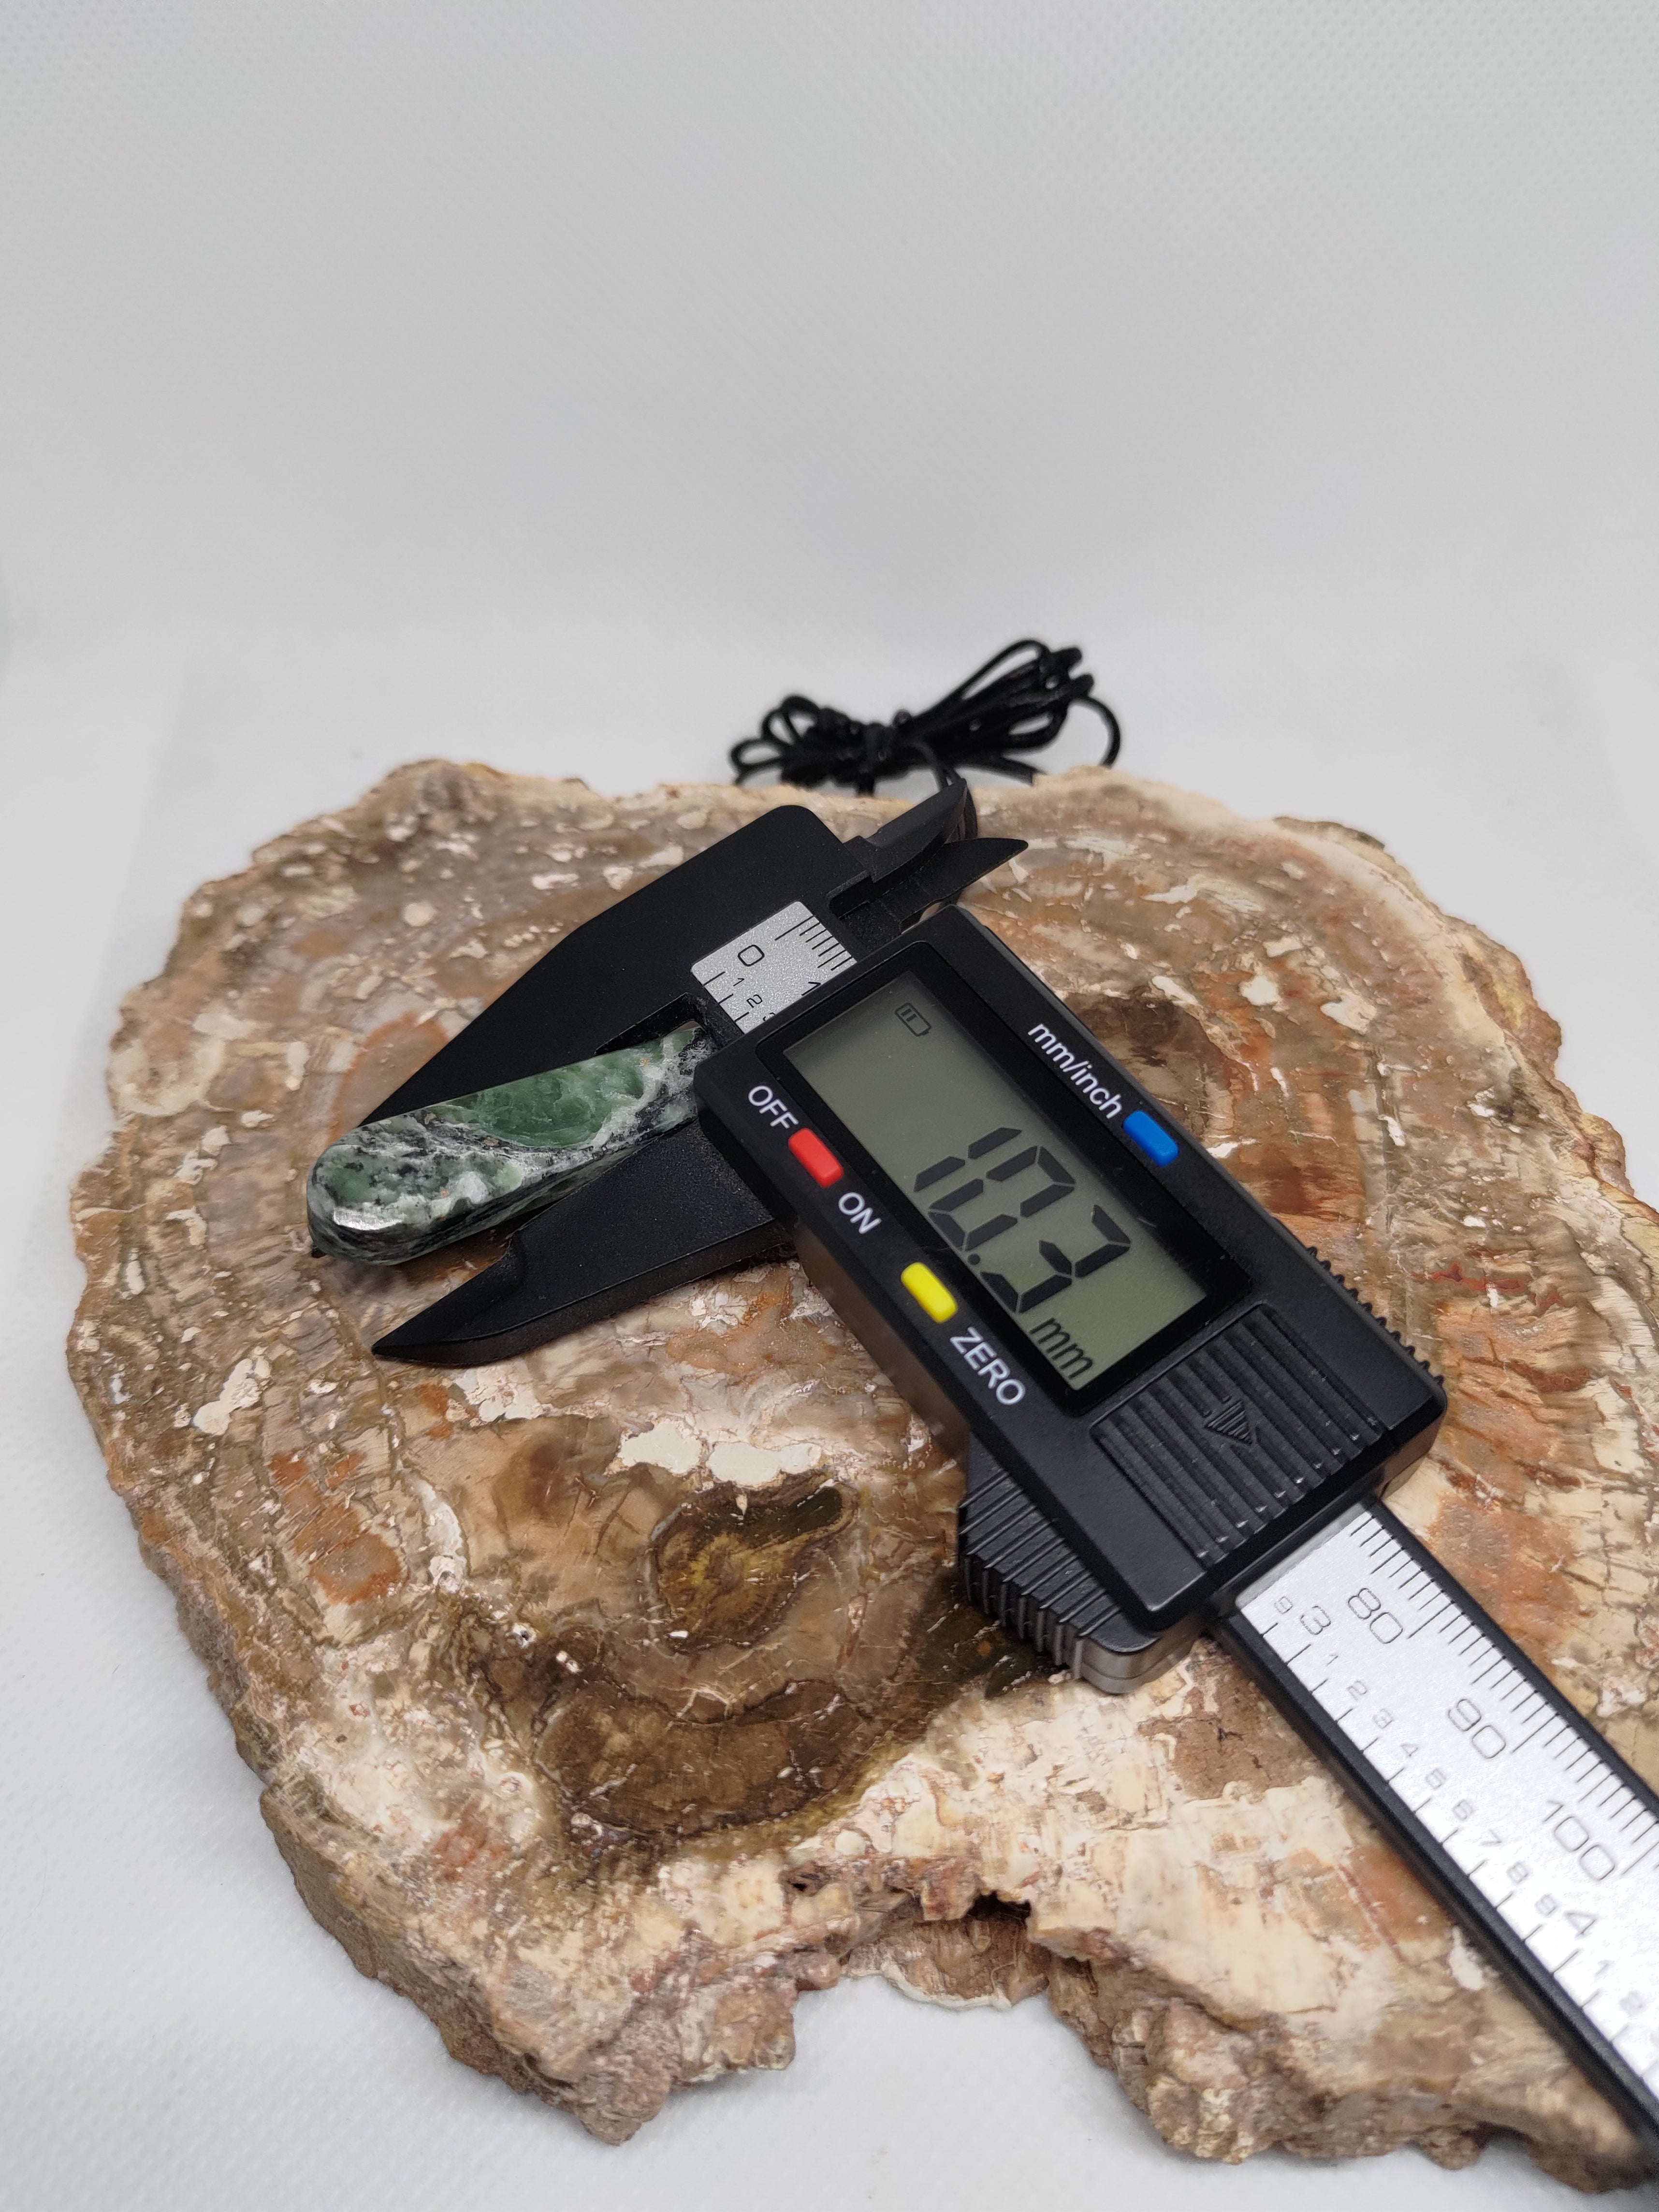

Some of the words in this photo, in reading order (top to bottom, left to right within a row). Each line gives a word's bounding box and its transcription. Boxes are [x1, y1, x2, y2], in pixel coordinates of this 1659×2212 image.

[733, 977, 745, 987] 1
[746, 994, 763, 1008] 2
[738, 945, 765, 967] 0
[748, 1085, 799, 1129] OFF
[1028, 1023, 1123, 1120] mm/inch
[838, 1192, 882, 1234] ON
[913, 1127, 1131, 1314] 10.3
[1029, 1317, 1094, 1381] mm
[949, 1326, 1026, 1406] ZERO
[1299, 1605, 1332, 1635] 3
[1326, 1653, 1339, 1666] 1
[1346, 1680, 1368, 1701] 2
[1372, 1708, 1394, 1730] 3
[1399, 1742, 1419, 1757] 4
[1564, 1910, 1599, 1938] 4
[1346, 1587, 1403, 1644] 80
[1448, 1699, 1507, 1759] 90
[1541, 1799, 1616, 1881] 100
